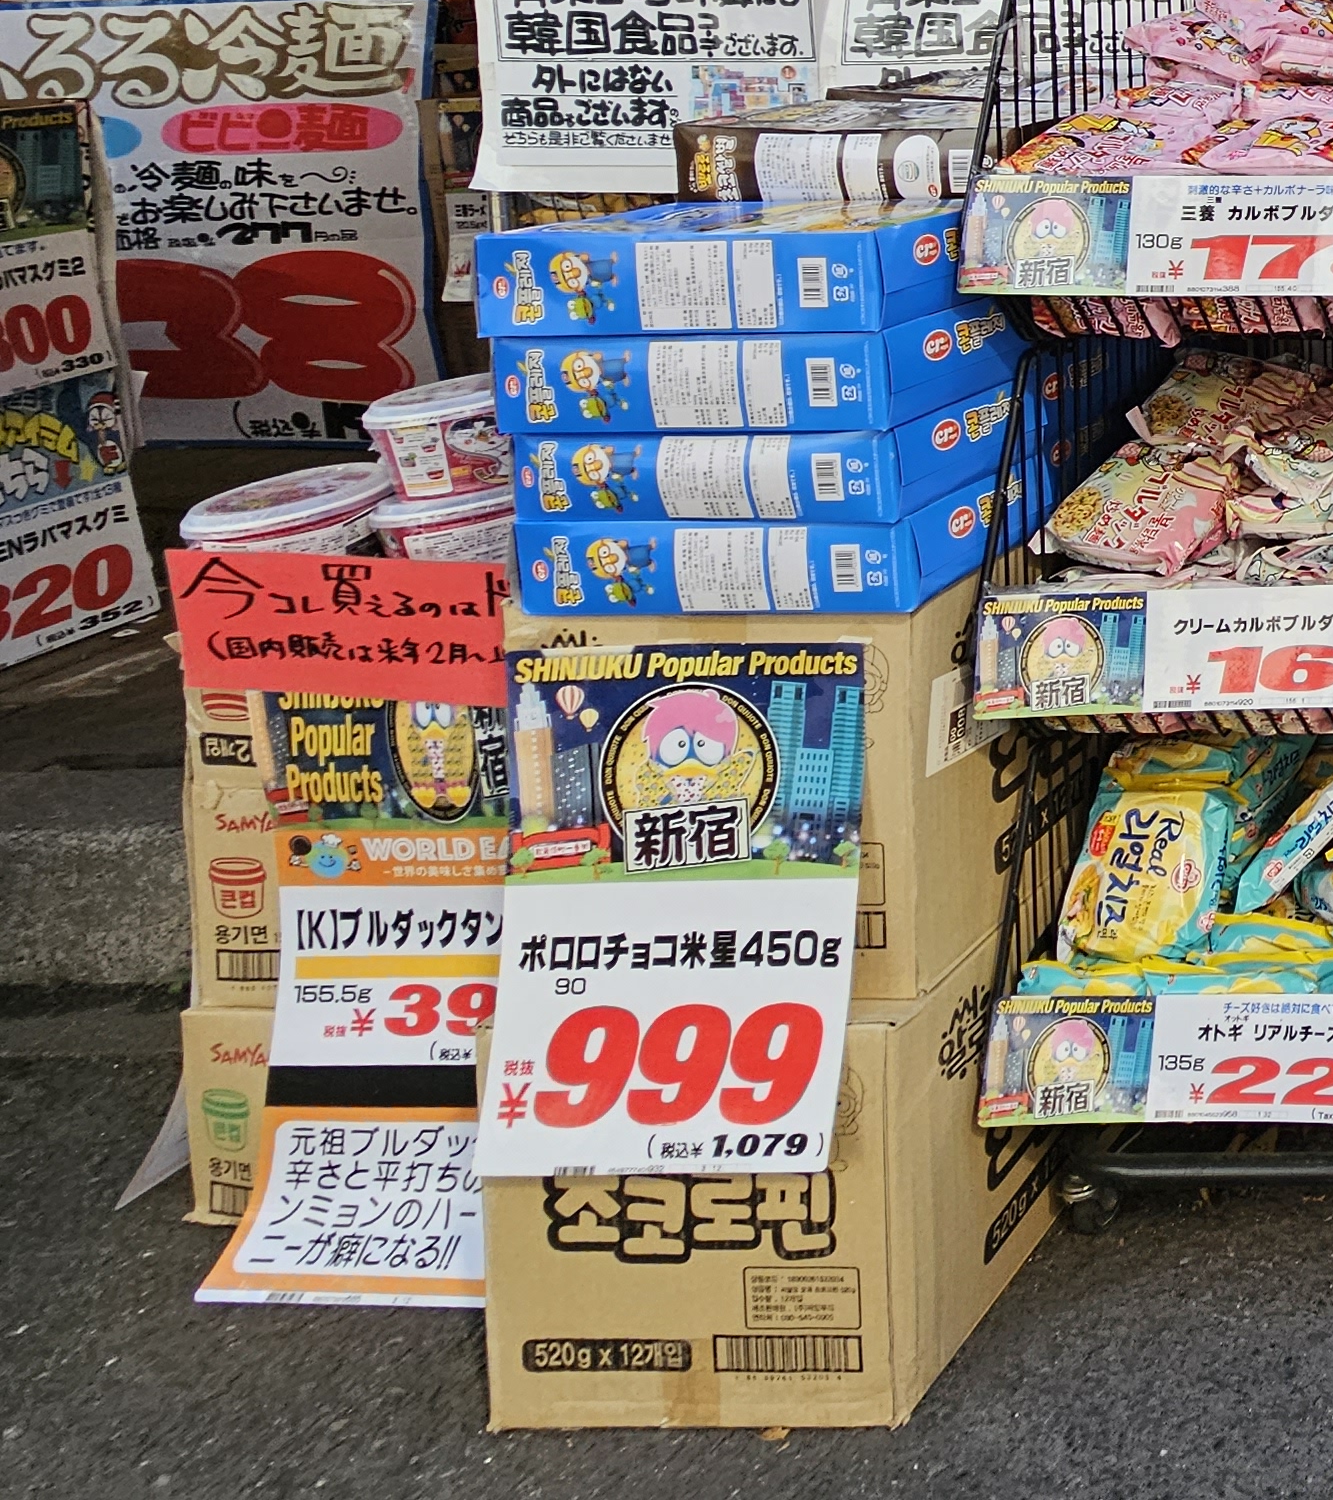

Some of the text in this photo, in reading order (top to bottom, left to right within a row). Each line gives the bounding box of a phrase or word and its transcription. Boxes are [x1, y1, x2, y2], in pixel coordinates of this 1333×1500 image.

[532, 64, 673, 94] 外にはない
[1036, 181, 1079, 195] Popular
[1081, 181, 1130, 194] Products
[1135, 233, 1183, 250] 130g
[1018, 258, 1071, 286] 新宿
[515, 650, 858, 684] SHINJUKU Popular Products
[1033, 679, 1086, 709] 新宿
[291, 722, 375, 757] Popular
[286, 767, 383, 803] Products
[360, 836, 475, 862] WORLD
[634, 805, 744, 868] 新宿
[214, 924, 269, 945] 용기면
[294, 984, 372, 1005] 155.5g
[1198, 1024, 1246, 1043] オトギ
[533, 1002, 824, 1129] 999
[1158, 1055, 1205, 1073] 135g
[534, 1342, 592, 1369] 520g
